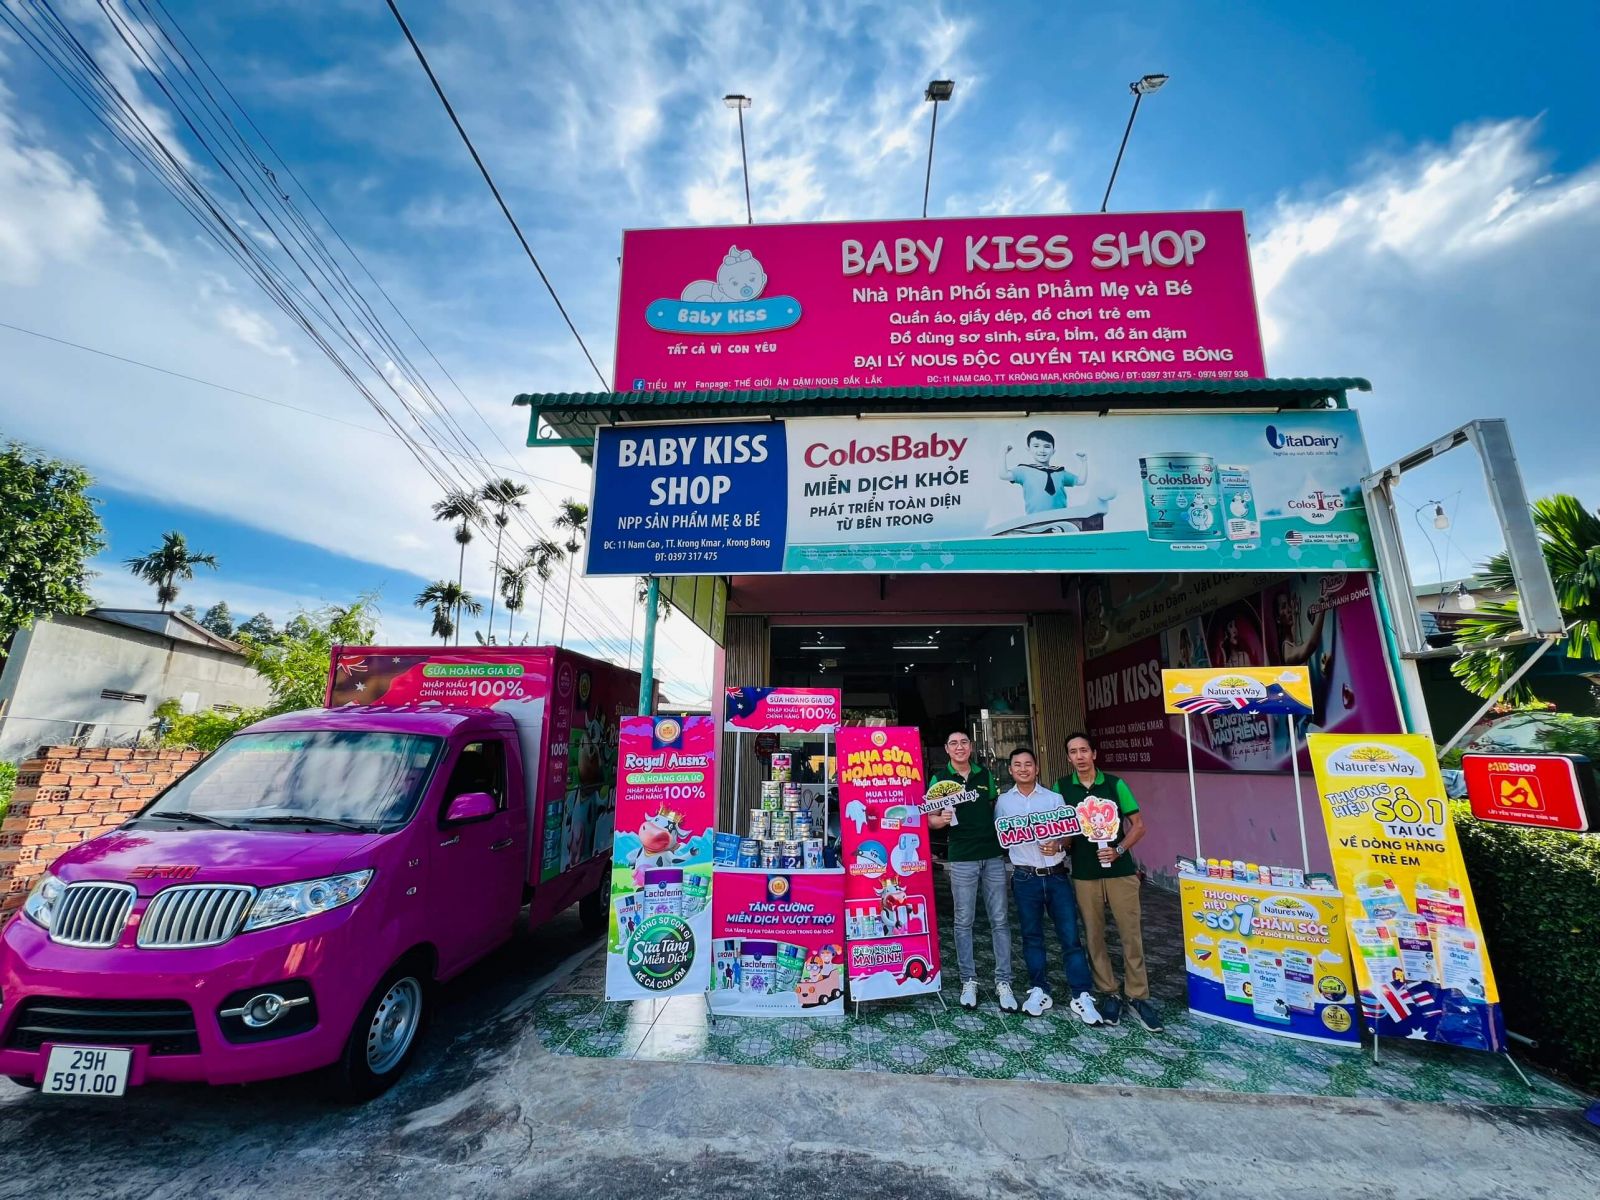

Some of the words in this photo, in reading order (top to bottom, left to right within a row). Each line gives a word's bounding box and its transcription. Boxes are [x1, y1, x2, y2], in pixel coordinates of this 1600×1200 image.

[842, 237, 943, 276] BABY
[966, 235, 1073, 272] KISS
[1091, 229, 1206, 269] SHOP
[852, 287, 888, 303] Nhà
[995, 284, 1030, 299] sản
[1100, 282, 1129, 300] Mẹ
[1135, 281, 1158, 296] và
[1165, 280, 1192, 296] Bé
[678, 308, 722, 325] Baby
[728, 308, 767, 323] Kiss
[934, 311, 956, 325] áo,
[995, 309, 1027, 324] dép,
[1057, 307, 1092, 320] chơi
[1099, 307, 1120, 320] trẻ
[1126, 308, 1151, 319] em
[917, 332, 954, 346] dùng
[959, 333, 981, 343] sơ
[985, 330, 1022, 344] sinh,
[1025, 329, 1060, 342] sữa,
[1064, 326, 1098, 342] bỉm,
[1128, 328, 1148, 340] ăn
[1152, 327, 1187, 342] dặm
[667, 343, 688, 355] TẤT
[691, 342, 706, 355] CẢ
[728, 344, 750, 354] CON
[755, 342, 777, 353] YÊU
[854, 355, 882, 370] ĐẠI
[888, 352, 906, 367] LÝ
[911, 354, 958, 367] NOUS
[962, 349, 1001, 368] ĐỘC
[1009, 346, 1071, 366] QUYỀN
[1078, 350, 1106, 366] TẠI
[1112, 347, 1175, 362] KRÔNG
[1183, 346, 1234, 362] BÔNG
[695, 380, 731, 390] Fanpage:
[735, 377, 751, 387] THẾ
[754, 377, 772, 387] GIỚI
[953, 374, 972, 383] NAM
[974, 374, 993, 383] CAO,
[1008, 371, 1039, 382] KRÔNG
[1095, 370, 1119, 380] BÔNG
[1162, 371, 1175, 379] 317
[1177, 371, 1191, 379] 475
[1198, 370, 1216, 378] 0974
[1218, 370, 1232, 378] 997
[1233, 370, 1248, 378] 938
[618, 437, 697, 468] BABY
[703, 434, 768, 465] KISS
[804, 432, 968, 468] ColosBaby
[804, 474, 851, 497] MIỄN
[858, 475, 908, 496] DỊCH
[915, 466, 969, 488] KHỎE
[1149, 473, 1213, 488] ColosBaby
[649, 475, 731, 506] SHOP
[810, 502, 844, 518] PHÁT
[848, 496, 884, 515] TRIỂN
[889, 495, 926, 510] TOÀN
[930, 494, 961, 510] DIỆN
[618, 516, 642, 529] NPP
[645, 512, 669, 529] SẢN
[672, 511, 708, 529] PHẨM
[711, 514, 729, 531] MẸ
[732, 514, 742, 527] &
[745, 510, 760, 527] BÉ
[836, 516, 852, 532] TỪ
[857, 515, 882, 530] BÊN
[886, 513, 934, 527] TRONG
[604, 541, 616, 550] ĐC:
[628, 541, 645, 549] Nam
[677, 539, 700, 550] Krong
[726, 538, 749, 549] Krong
[751, 537, 771, 549] Bong
[655, 552, 667, 562] ĐT:
[668, 551, 687, 561] 0397
[688, 551, 702, 561] 317
[703, 551, 718, 561] 475
[427, 664, 448, 676] SỮA
[449, 664, 485, 676] HOÀNG
[487, 665, 505, 675] GIA
[506, 664, 520, 675] ÚC
[419, 688, 446, 698] CHÍNH
[422, 682, 444, 690] NHẬP
[445, 680, 467, 689] KHẨU
[469, 681, 525, 697] 100%
[1087, 672, 1119, 712] BABY
[1121, 659, 1162, 704] KISS
[1207, 688, 1241, 696] Nature's
[1242, 688, 1261, 697] Way
[800, 707, 836, 720] 100%
[625, 753, 664, 771] Royal
[668, 753, 707, 769] Ausnz
[847, 750, 880, 767] MUA
[882, 746, 913, 765] SỮA
[842, 760, 894, 783] HOÀNG
[895, 764, 921, 781] GIA
[1335, 762, 1386, 773] Nature's
[1390, 763, 1415, 776] Way
[663, 785, 705, 799] 100%
[865, 790, 882, 798] MUA
[1325, 783, 1390, 805] THƯƠNG
[918, 794, 956, 814] Nature's
[959, 789, 978, 804] Way
[1332, 801, 1369, 819] HIỆU
[1372, 786, 1422, 824] SỐ
[1427, 798, 1443, 825] 1
[998, 815, 1029, 831] #Tây
[1030, 805, 1074, 825] Nguyên
[1001, 827, 1033, 845] MÃI
[1034, 818, 1079, 839] ĐỈNH
[1388, 825, 1412, 838] TẠI
[1415, 824, 1436, 837] ÚC
[1340, 835, 1358, 848] VỀ
[1361, 838, 1401, 850] DÒNG
[1406, 839, 1446, 853] HÀNG
[1372, 852, 1397, 865] TRẺ
[1401, 856, 1421, 866] EM
[644, 889, 683, 898] Lactoferrin
[1203, 889, 1249, 903] THƯƠNG
[749, 902, 776, 912] TĂNG
[777, 902, 814, 912] CƯỜNG
[1203, 901, 1227, 911] HIỆU
[1264, 906, 1296, 916] Nature's
[1298, 910, 1314, 919] Way
[726, 911, 752, 923] MIỄN
[754, 914, 780, 925] DỊCH
[782, 915, 810, 925] VƯỢT
[812, 913, 835, 925] TRỘI
[1251, 916, 1296, 933] CHĂM
[1298, 921, 1329, 936] SÓC
[661, 939, 690, 953] Tăng
[643, 954, 665, 965] Miễn
[667, 952, 688, 964] Dịch
[740, 960, 777, 970] Lactoferrin
[657, 979, 674, 989] CON
[70, 1050, 108, 1072] 29H
[52, 1072, 117, 1094] 591.00
